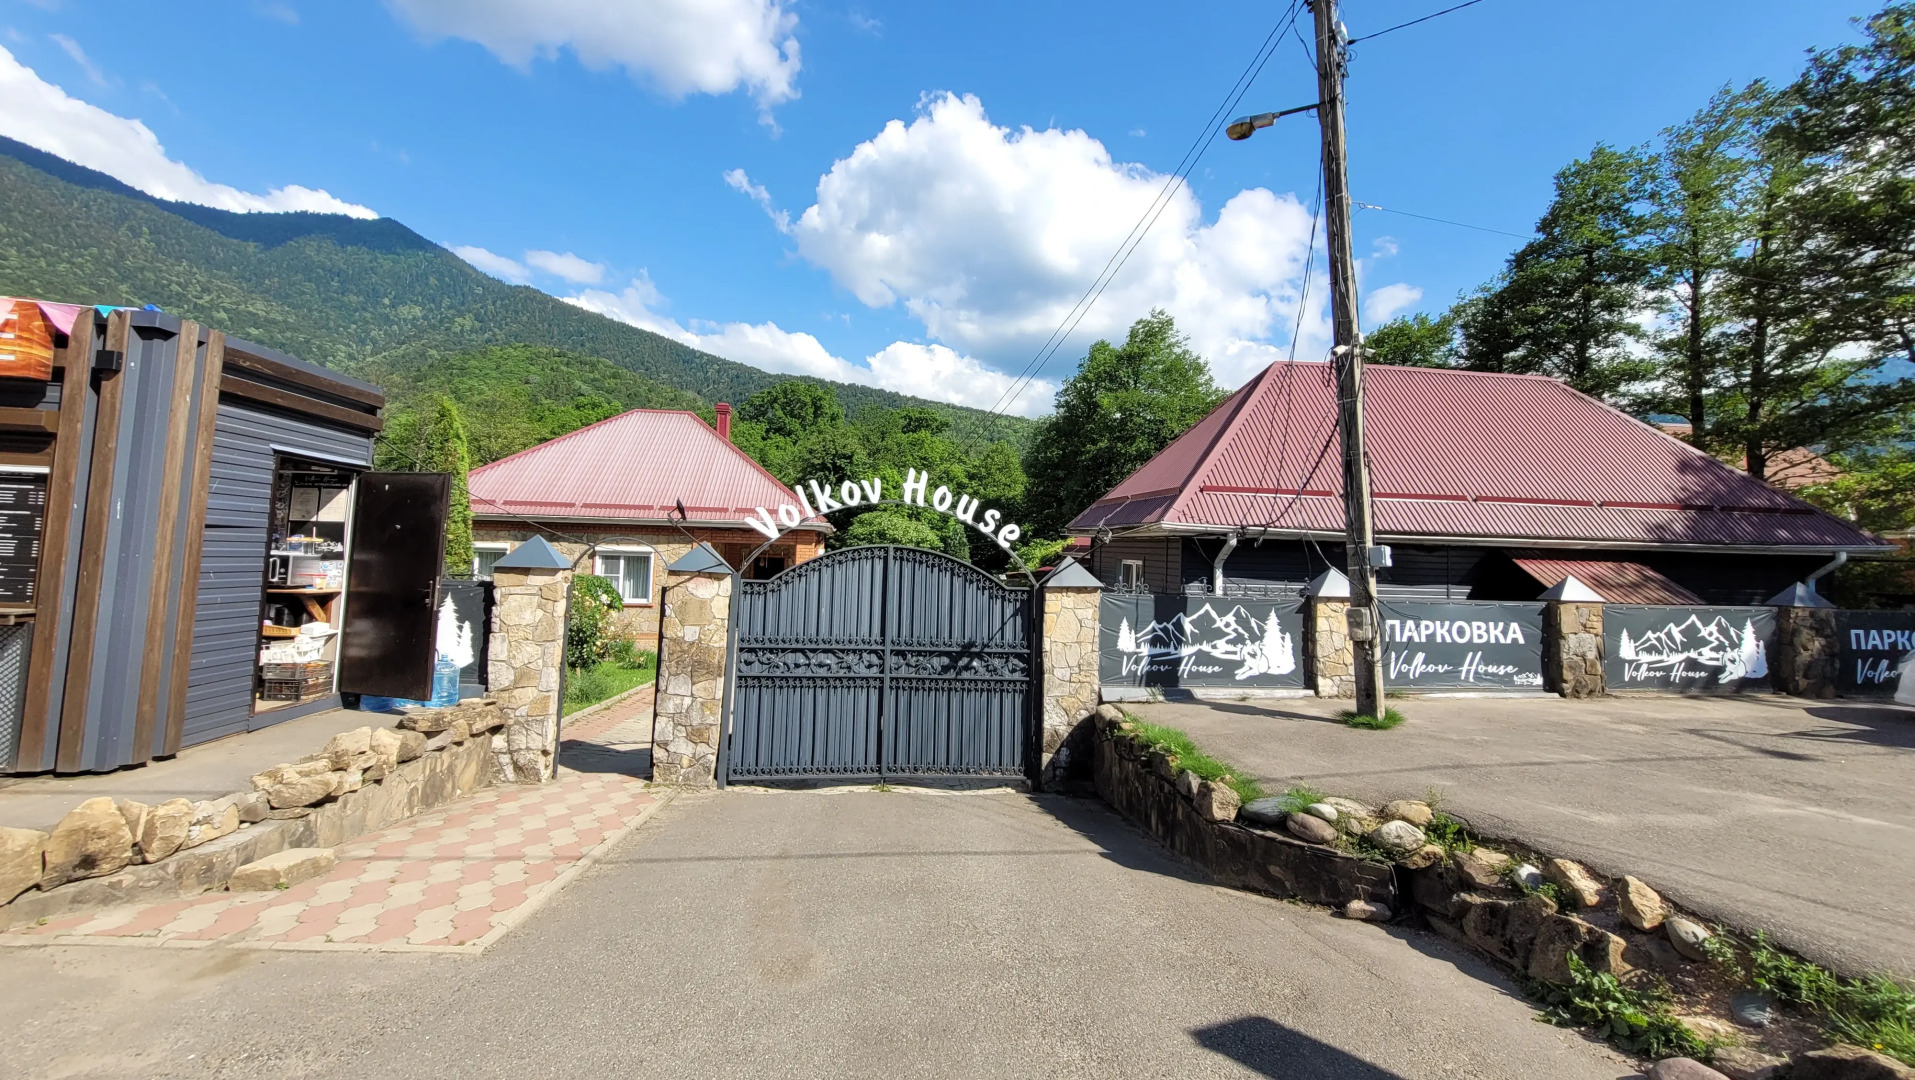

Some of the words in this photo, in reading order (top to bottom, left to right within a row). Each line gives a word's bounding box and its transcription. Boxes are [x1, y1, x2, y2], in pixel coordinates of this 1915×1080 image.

[744, 478, 881, 540] Volkov
[903, 467, 1021, 548] House
[1385, 620, 1525, 645] ПАРКОВКА
[1850, 629, 1915, 651] ПАРК
[1122, 655, 1172, 677] Volkov
[1177, 655, 1223, 679] House
[1389, 650, 1453, 680] Volkov
[1458, 651, 1518, 682] House
[1624, 662, 1666, 682] Volkov
[1669, 662, 1708, 683] House
[1857, 657, 1900, 684] Volko
